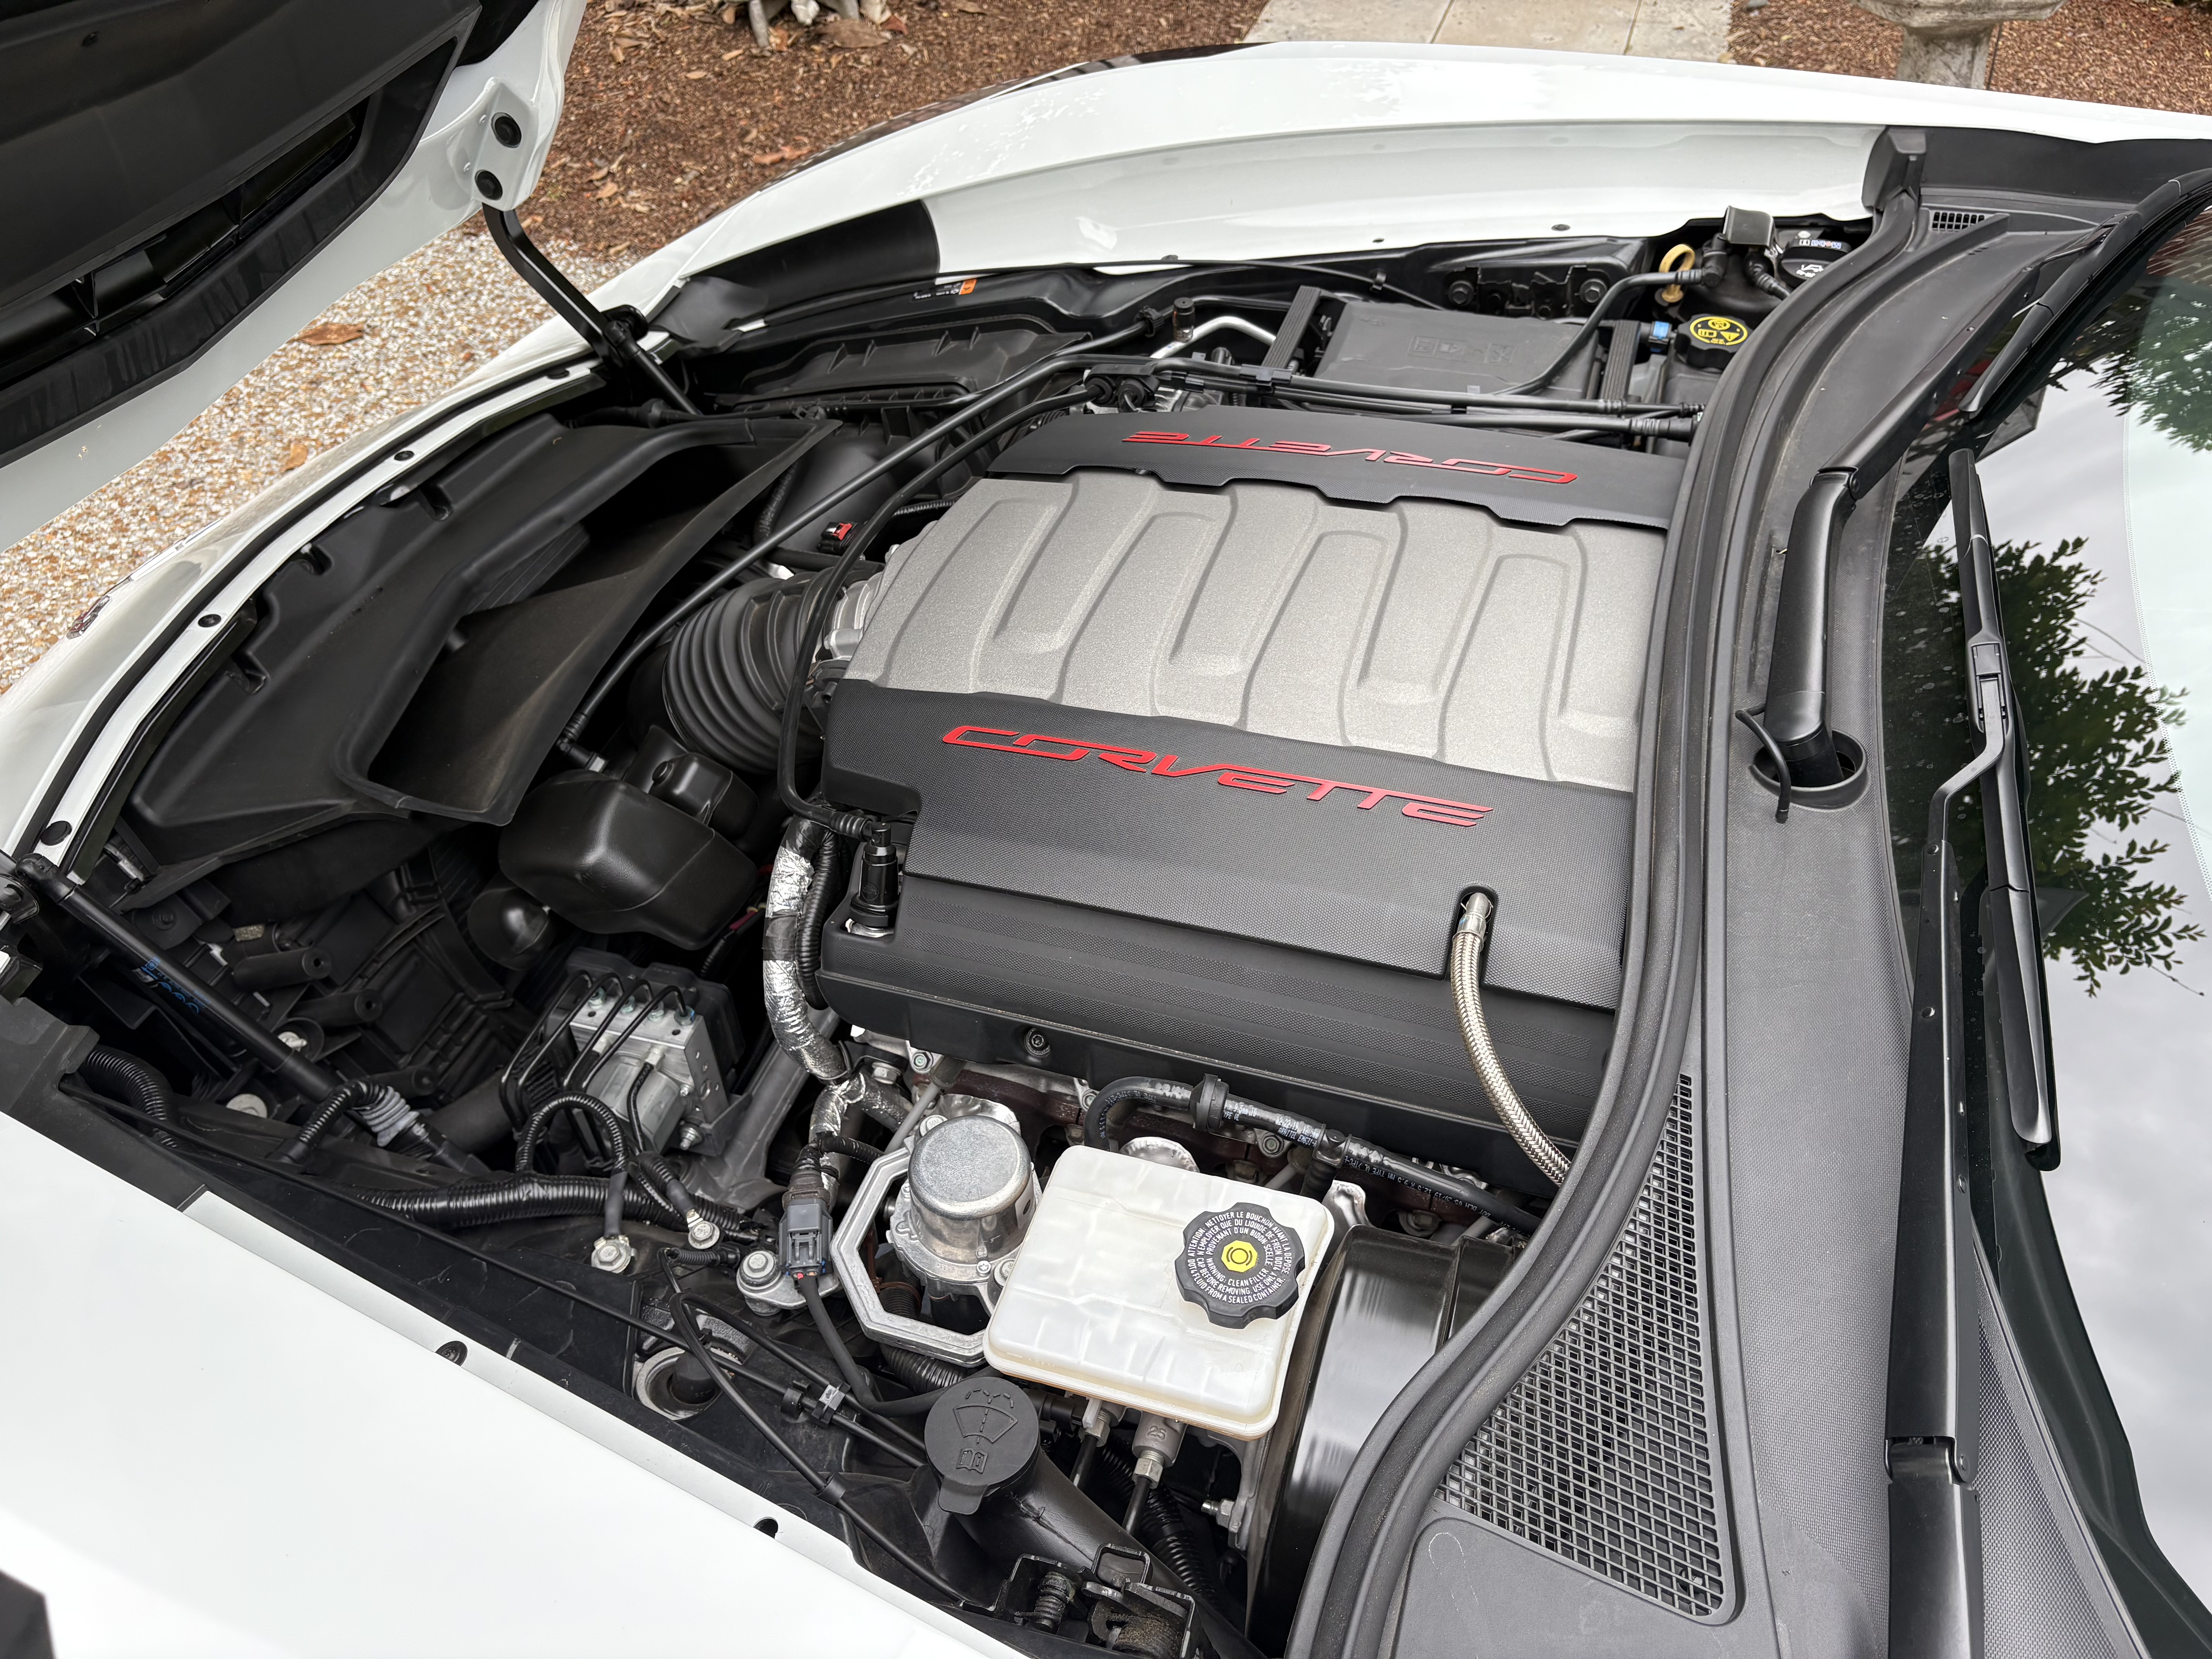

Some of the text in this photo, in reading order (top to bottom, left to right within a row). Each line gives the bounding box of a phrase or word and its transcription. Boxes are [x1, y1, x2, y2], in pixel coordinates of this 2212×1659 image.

[1122, 431, 1578, 484] CORVETTE
[942, 725, 1494, 826] CORVETTE
[1205, 1212, 1235, 1228] NETTOYER
[1246, 1212, 1274, 1228] BOUCHON
[1271, 1226, 1288, 1242] AVANT
[1187, 1227, 1207, 1257] ATTENTION:
[1197, 1225, 1221, 1255] N'EMPLOYER
[1220, 1220, 1233, 1229] QUE
[1245, 1220, 1267, 1234] LIQUIDE
[1265, 1231, 1275, 1240] DE
[1271, 1238, 1283, 1255] FREIN
[1206, 1228, 1232, 1255] PROVENANT
[1282, 1243, 1291, 1252] LA
[1196, 1257, 1278, 1295] CAP BEFORE REMOVING. USE ONLY
[1206, 1257, 1269, 1287] WARNING: CLEAN FILLER
[1280, 1252, 1292, 1275] DEPOSE.
[1192, 1273, 1207, 1289] FLUID
[1204, 1286, 1223, 1300] FROM
[1228, 1295, 1253, 1304] SEALED
[1253, 1278, 1286, 1301] CONTAINER.
[1147, 1425, 1166, 1440] 25
